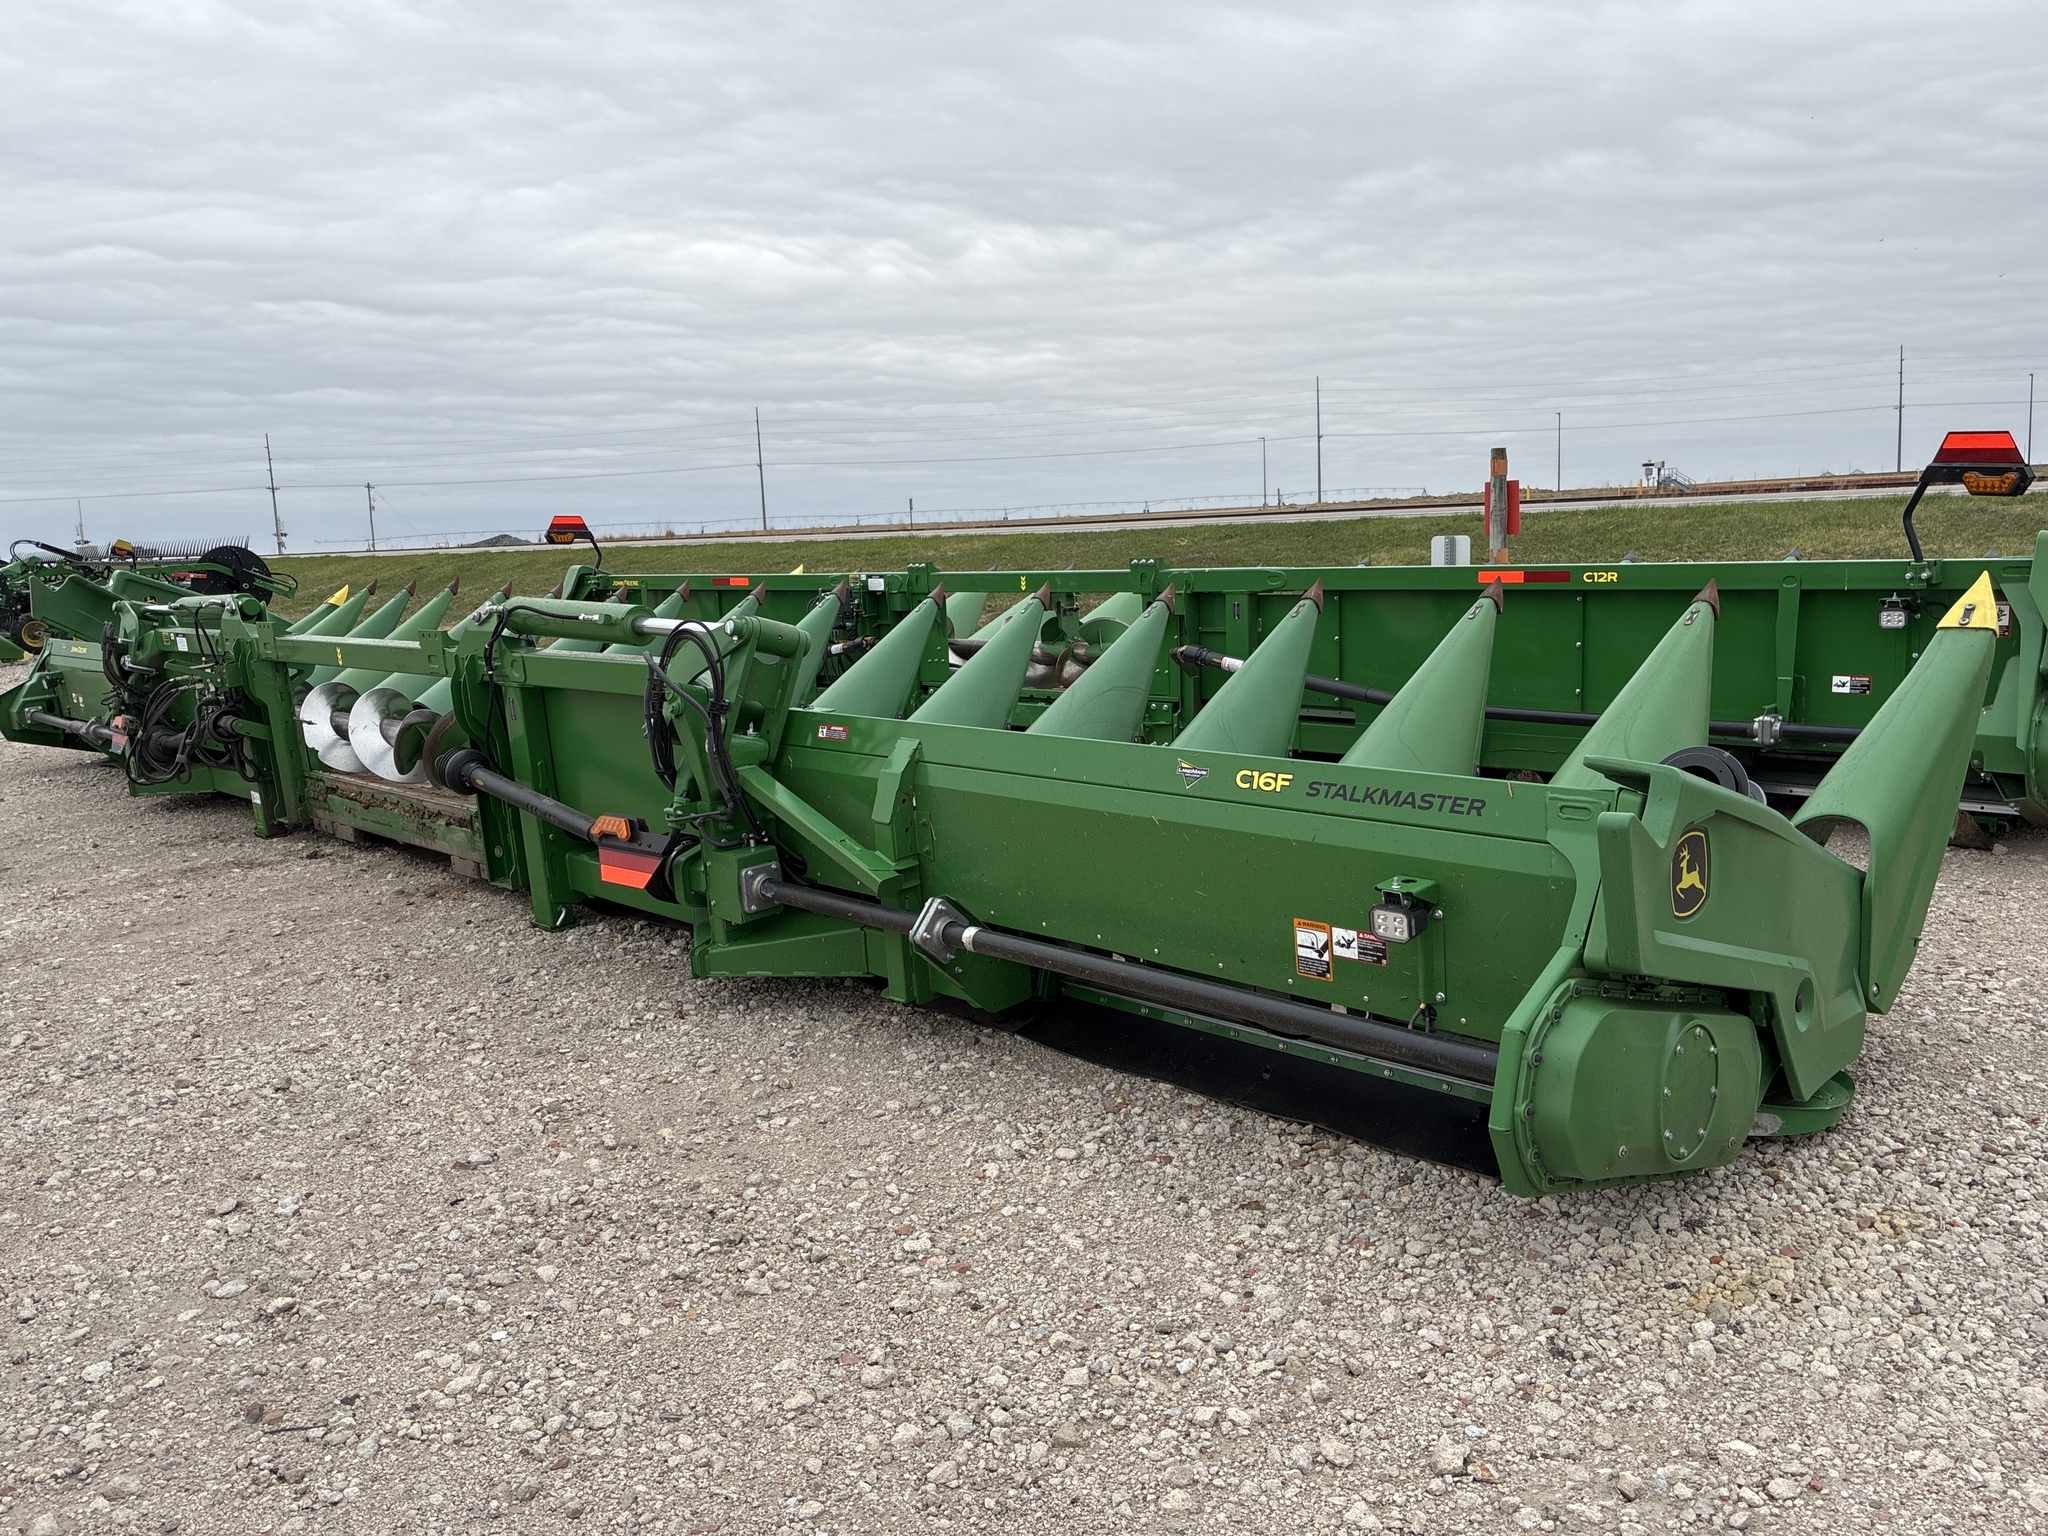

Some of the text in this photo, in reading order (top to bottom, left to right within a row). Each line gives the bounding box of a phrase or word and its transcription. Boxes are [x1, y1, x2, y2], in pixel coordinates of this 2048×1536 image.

[1582, 571, 1618, 583] C12R
[1235, 769, 1487, 817] C16F STALKMASTER
[1302, 921, 1326, 930] WARNING
